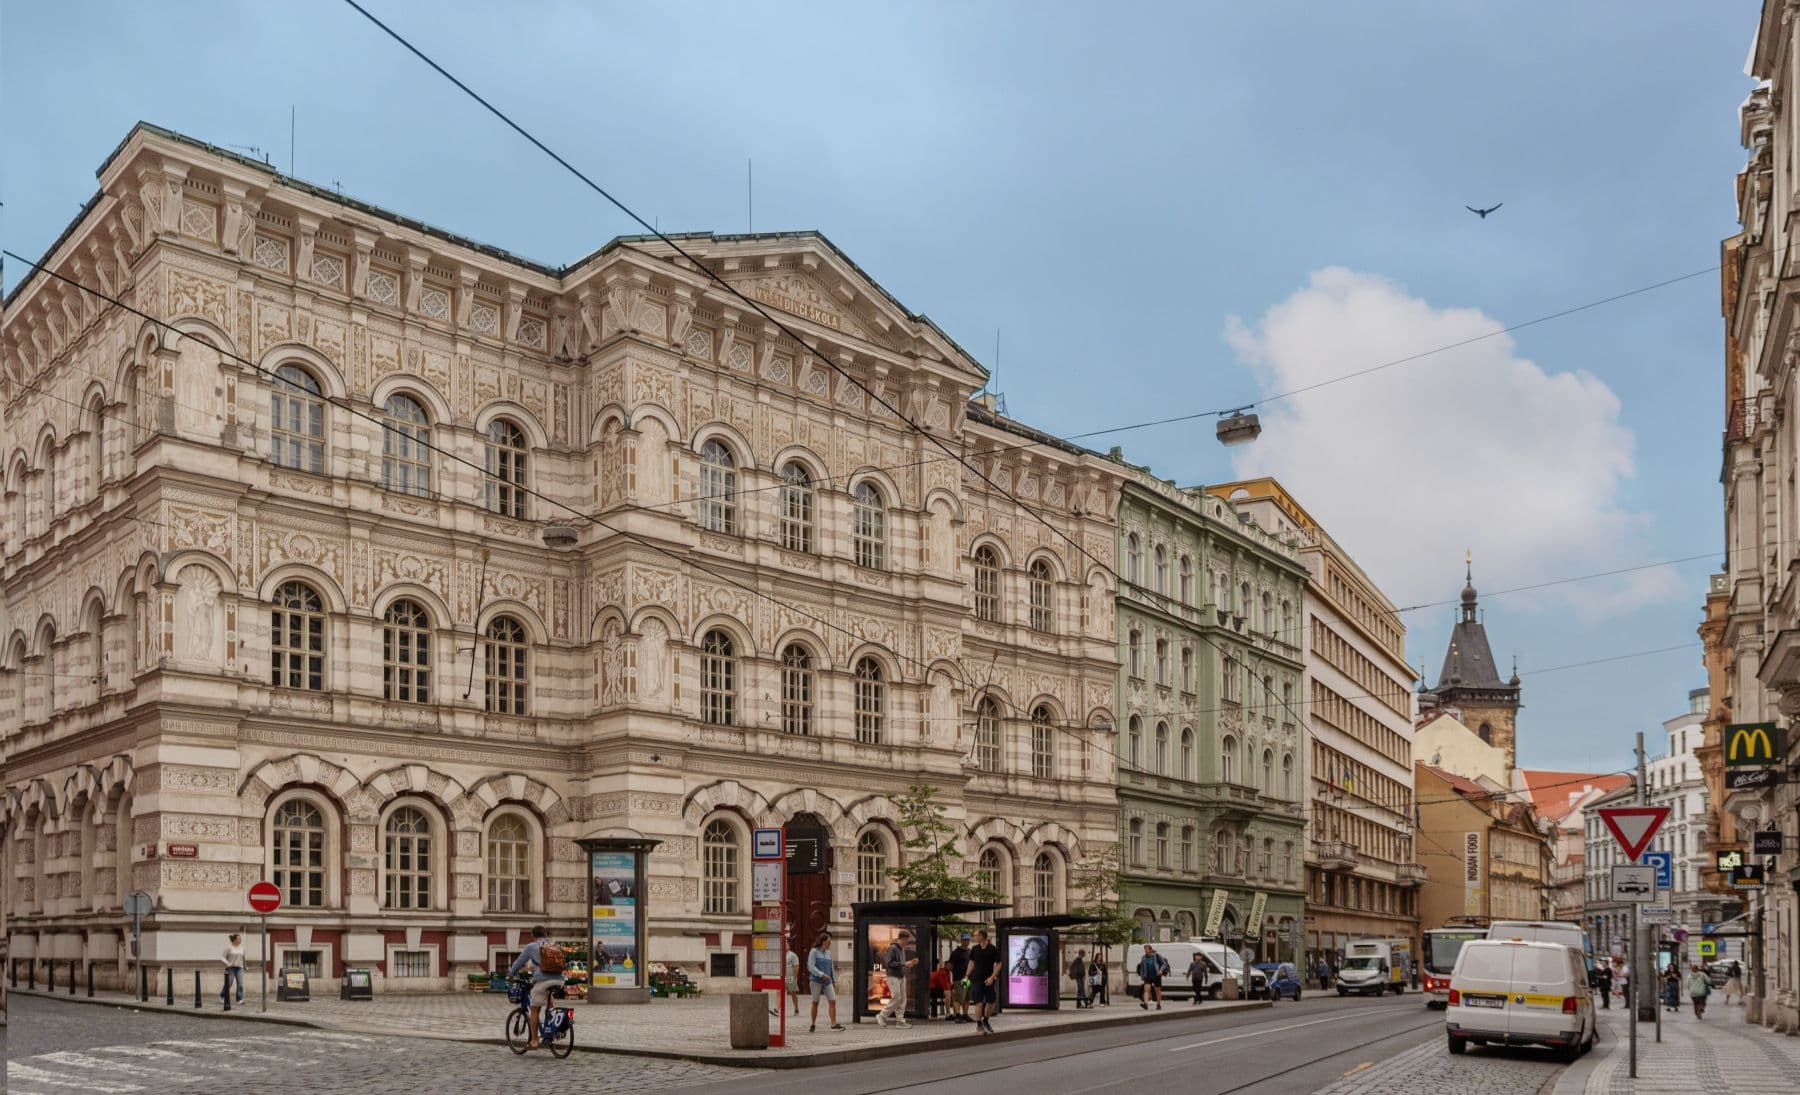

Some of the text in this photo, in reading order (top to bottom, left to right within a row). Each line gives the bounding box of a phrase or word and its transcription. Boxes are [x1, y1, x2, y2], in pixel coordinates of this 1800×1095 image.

[809, 305, 838, 328] ŠKOLA
[1467, 833, 1478, 881] INDIAN FOOD
